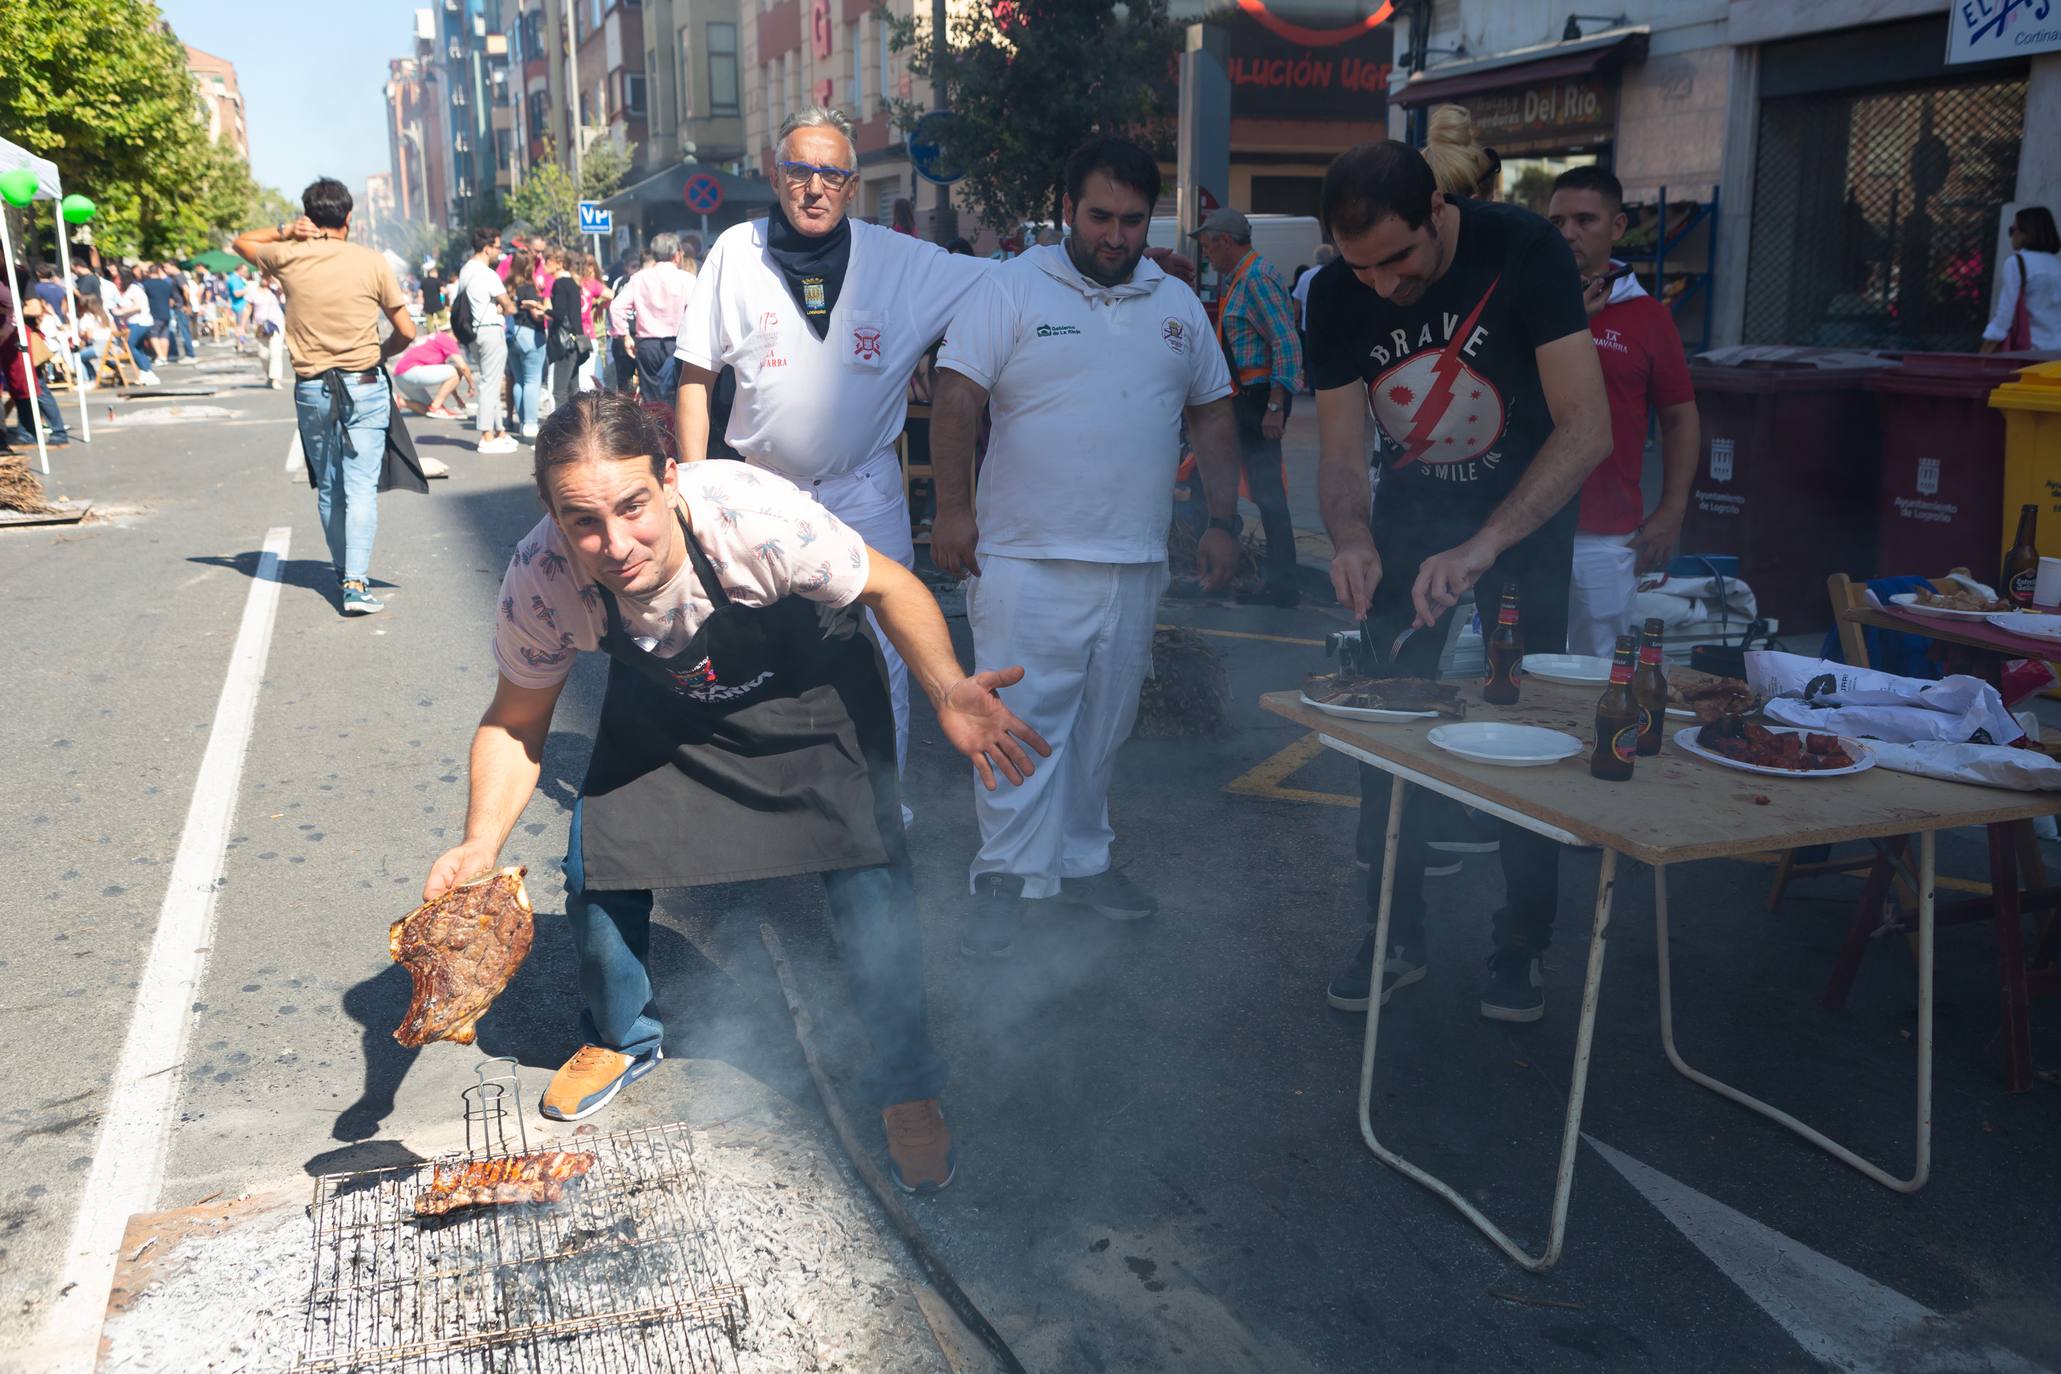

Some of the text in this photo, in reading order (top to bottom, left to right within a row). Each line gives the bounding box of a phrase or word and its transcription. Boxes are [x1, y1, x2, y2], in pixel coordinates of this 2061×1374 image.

[2015, 28, 2061, 47] Cortina
[1524, 85, 1557, 123] Del
[1369, 311, 1489, 367] BRAVE
[1421, 462, 1479, 483] SMILE
[1695, 490, 1746, 505] Ayuntamiento
[1699, 502, 1709, 511] de
[1895, 496, 1958, 513] Ayuntamiento
[1900, 508, 1912, 518] de
